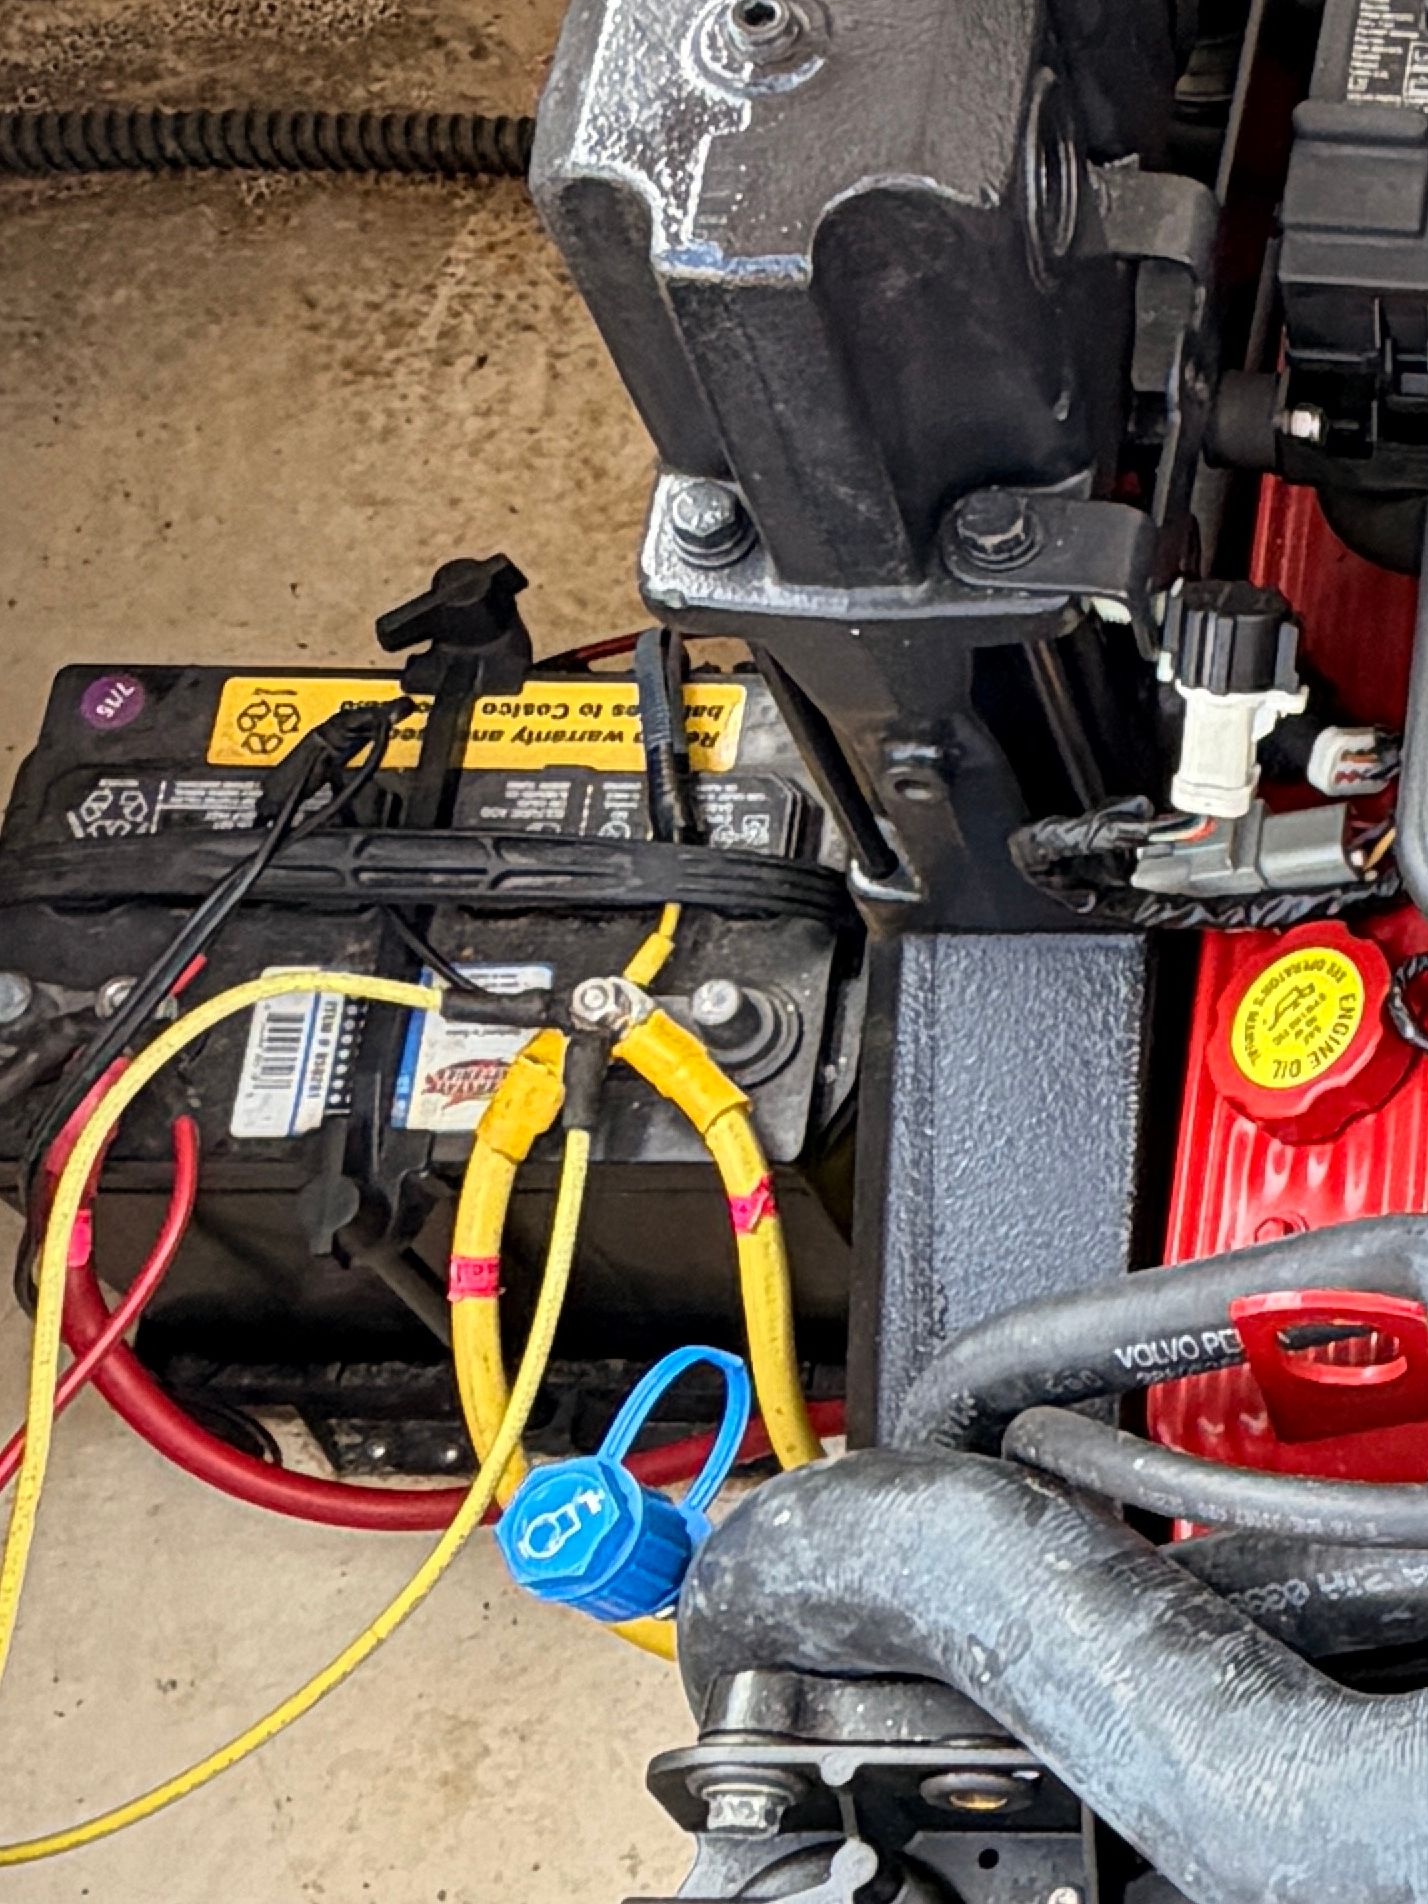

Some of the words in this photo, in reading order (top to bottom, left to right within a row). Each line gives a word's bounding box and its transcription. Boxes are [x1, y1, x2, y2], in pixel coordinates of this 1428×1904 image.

[480, 700, 571, 720] Costco
[577, 701, 603, 720] to
[510, 725, 625, 747] warranty
[1306, 992, 1357, 1070] ENGINE
[1272, 1058, 1302, 1080] OIL
[1113, 1334, 1201, 1370] VOLVO
